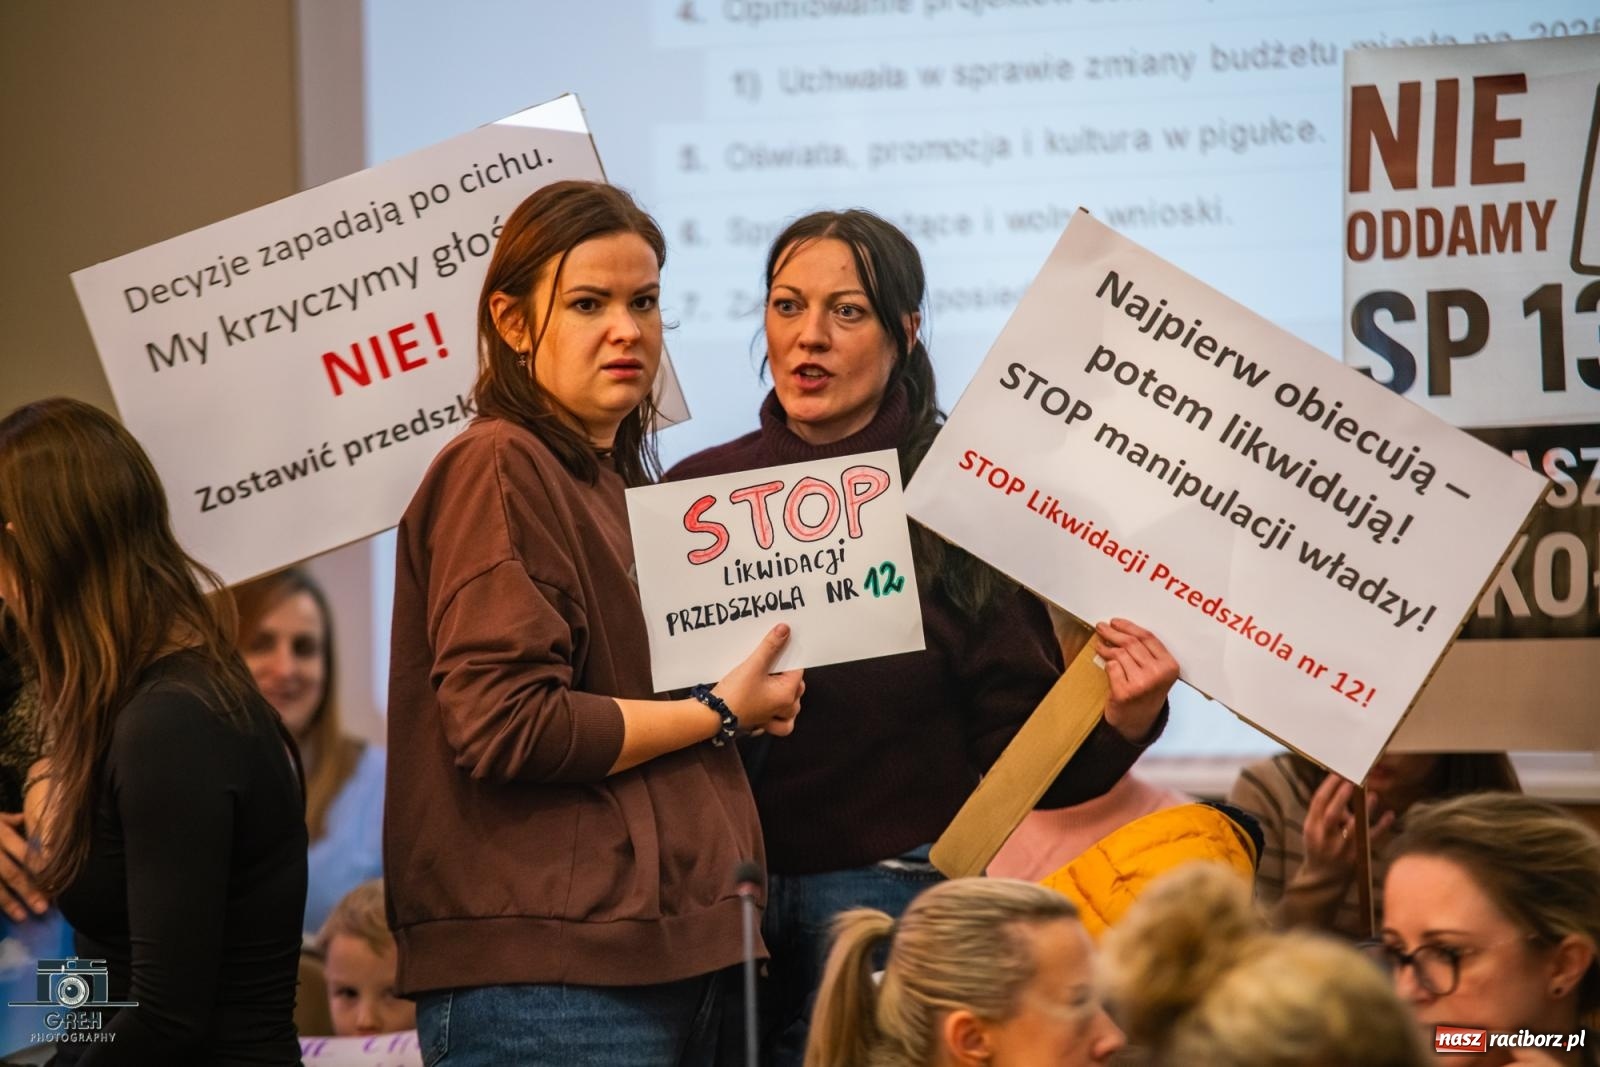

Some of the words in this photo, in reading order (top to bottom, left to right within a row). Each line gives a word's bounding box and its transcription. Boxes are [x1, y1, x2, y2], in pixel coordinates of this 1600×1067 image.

[919, 66, 943, 88] w
[952, 53, 1074, 89] sprawie
[1085, 47, 1197, 81] zmiany
[1210, 39, 1338, 72] budżetu
[1043, 124, 1151, 157] kultura
[1163, 124, 1191, 149] w
[1200, 115, 1325, 154] pigułce.
[1349, 73, 1528, 194] NIE
[124, 256, 250, 313] Decyzje
[258, 202, 404, 266] zapadają
[409, 184, 450, 218] po
[460, 147, 552, 193] cichu.
[1346, 199, 1557, 262] ODDAMY
[145, 332, 207, 372] My
[219, 256, 417, 346] krzyczymy
[321, 312, 448, 396] NIE!
[1350, 288, 1491, 398] SP
[1522, 280, 1600, 393] 13
[1096, 271, 1270, 387] Najpierw
[1275, 383, 1436, 495] obiecują
[194, 443, 336, 513] Zostawić
[1000, 363, 1092, 424] STOP
[1095, 423, 1296, 550] manipulacji
[1299, 541, 1437, 632] władzy!
[1085, 345, 1212, 431] potem
[1219, 414, 1414, 544] likwidują!
[683, 465, 891, 565] STOP
[666, 586, 806, 637] PRZEDSZKOLA
[826, 578, 860, 604] NR
[864, 561, 905, 598] 12
[959, 450, 1025, 495] STOP
[1027, 490, 1149, 573] Likwidacji
[1150, 563, 1292, 660] Przedszkola
[1297, 653, 1328, 678] nr
[1331, 673, 1376, 707] 12!
[1477, 530, 1600, 618] KO
